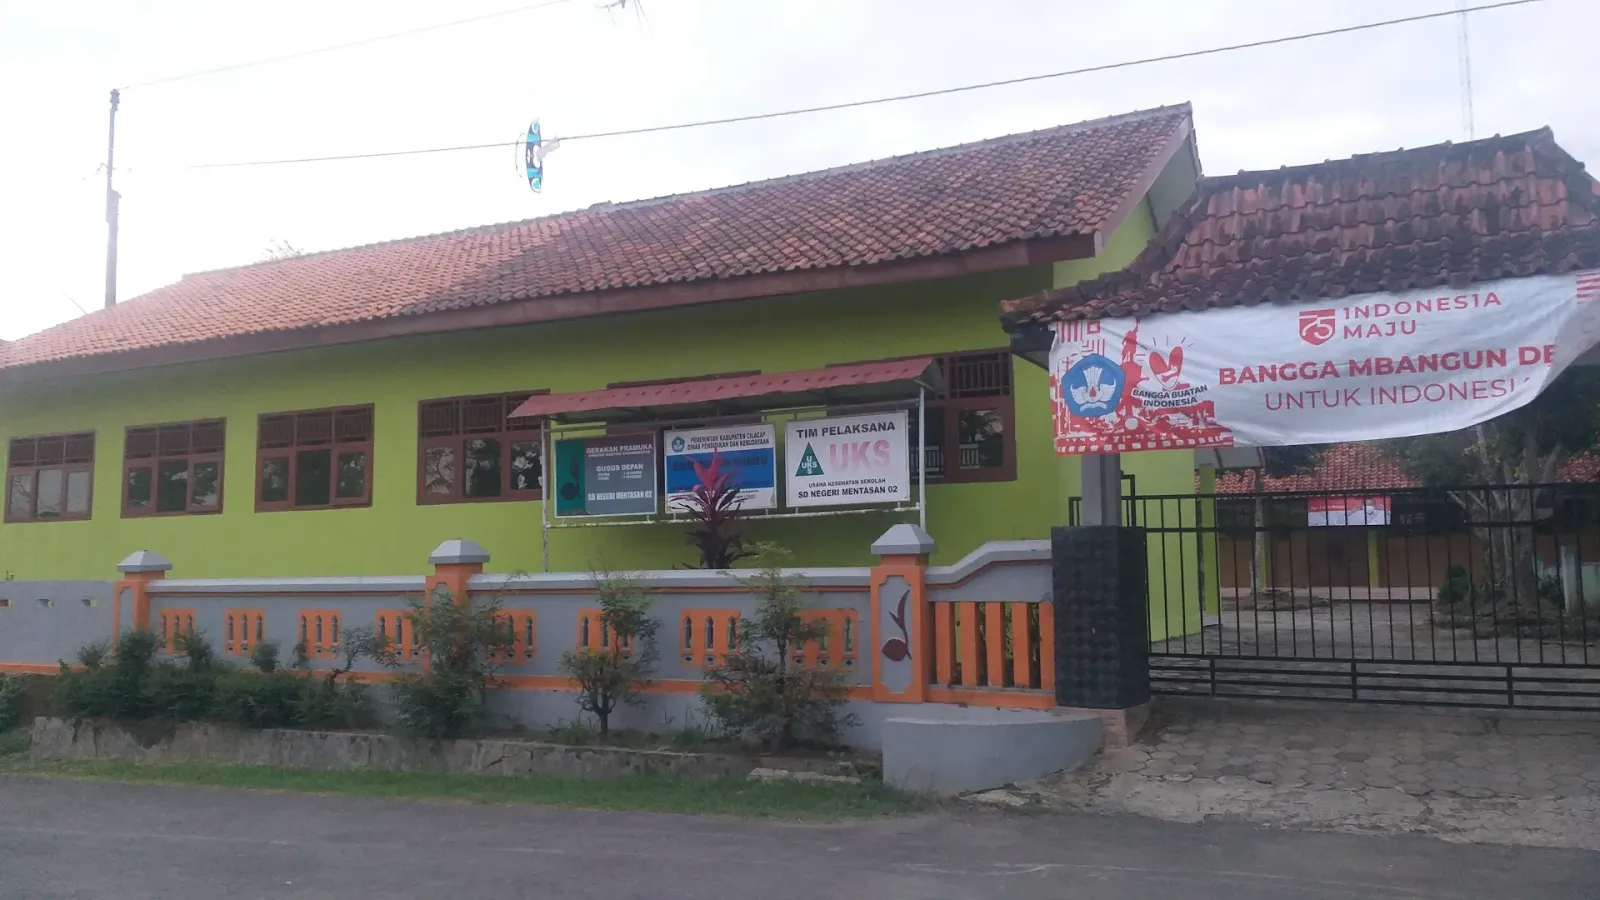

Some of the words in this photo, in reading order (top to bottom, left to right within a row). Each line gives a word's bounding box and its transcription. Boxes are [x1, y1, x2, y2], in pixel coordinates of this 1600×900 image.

[1343, 291, 1502, 320] INDONESIA
[1343, 319, 1417, 340] MAJU
[1219, 358, 1341, 386] BANGGA
[1349, 348, 1507, 378] MBANGUN
[1132, 389, 1171, 400] BANGGA
[1171, 385, 1208, 398] BUATAN
[1143, 397, 1198, 407] INDONESIA
[1265, 386, 1363, 412] UNTUK
[1370, 377, 1531, 406] INDONESI
[719, 433, 746, 441] KABUPATEN
[747, 431, 766, 439] CILACAP
[796, 429, 818, 439] TIM
[821, 421, 896, 437] PELAKSANA
[829, 439, 891, 473] UKS
[798, 491, 809, 499] SD
[810, 489, 840, 498] NEGERI
[841, 486, 886, 496] MENTASAN
[887, 485, 898, 493] 02
